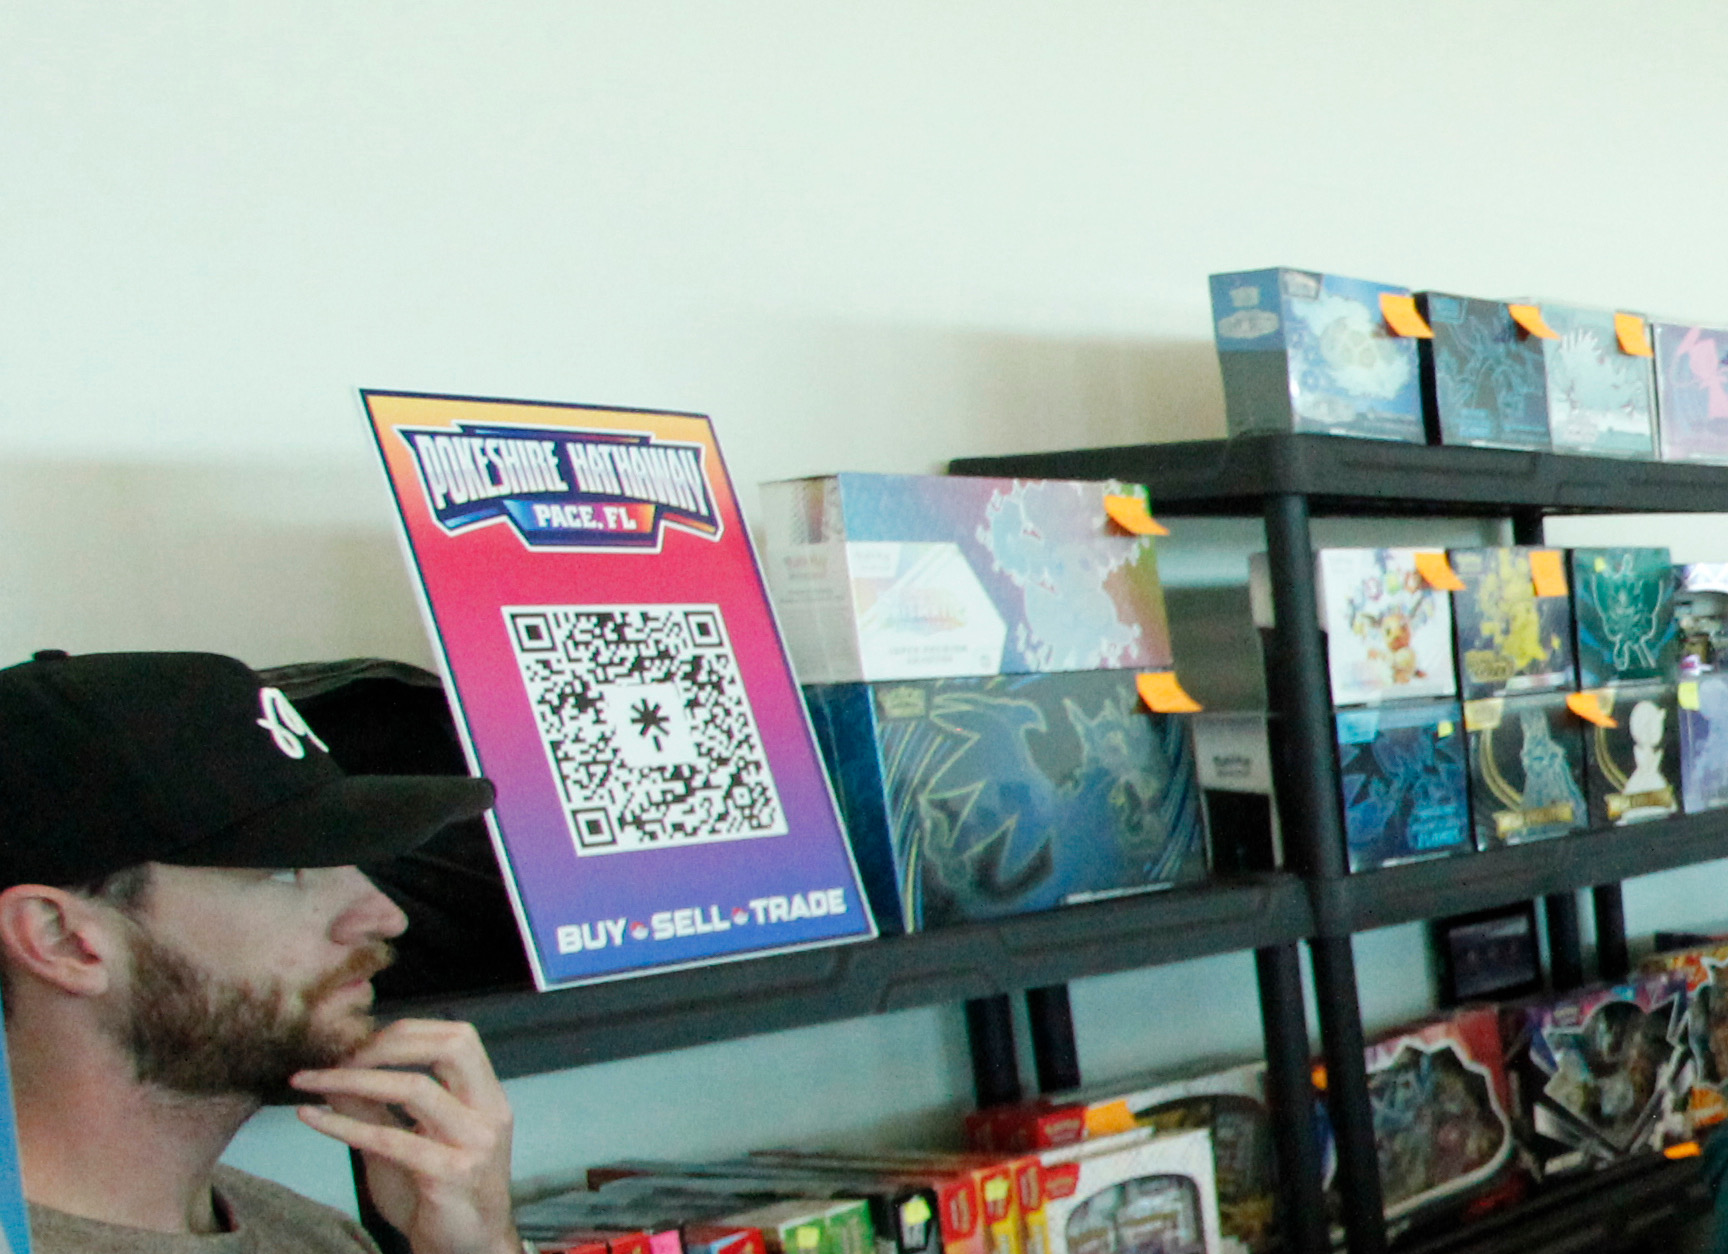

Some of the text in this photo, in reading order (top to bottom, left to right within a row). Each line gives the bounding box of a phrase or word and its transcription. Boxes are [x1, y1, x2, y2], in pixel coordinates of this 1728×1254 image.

[413, 434, 710, 517] POKESHIRE HATHAWAY
[603, 505, 637, 530] FL
[556, 886, 848, 955] BUY SELL TRADE
